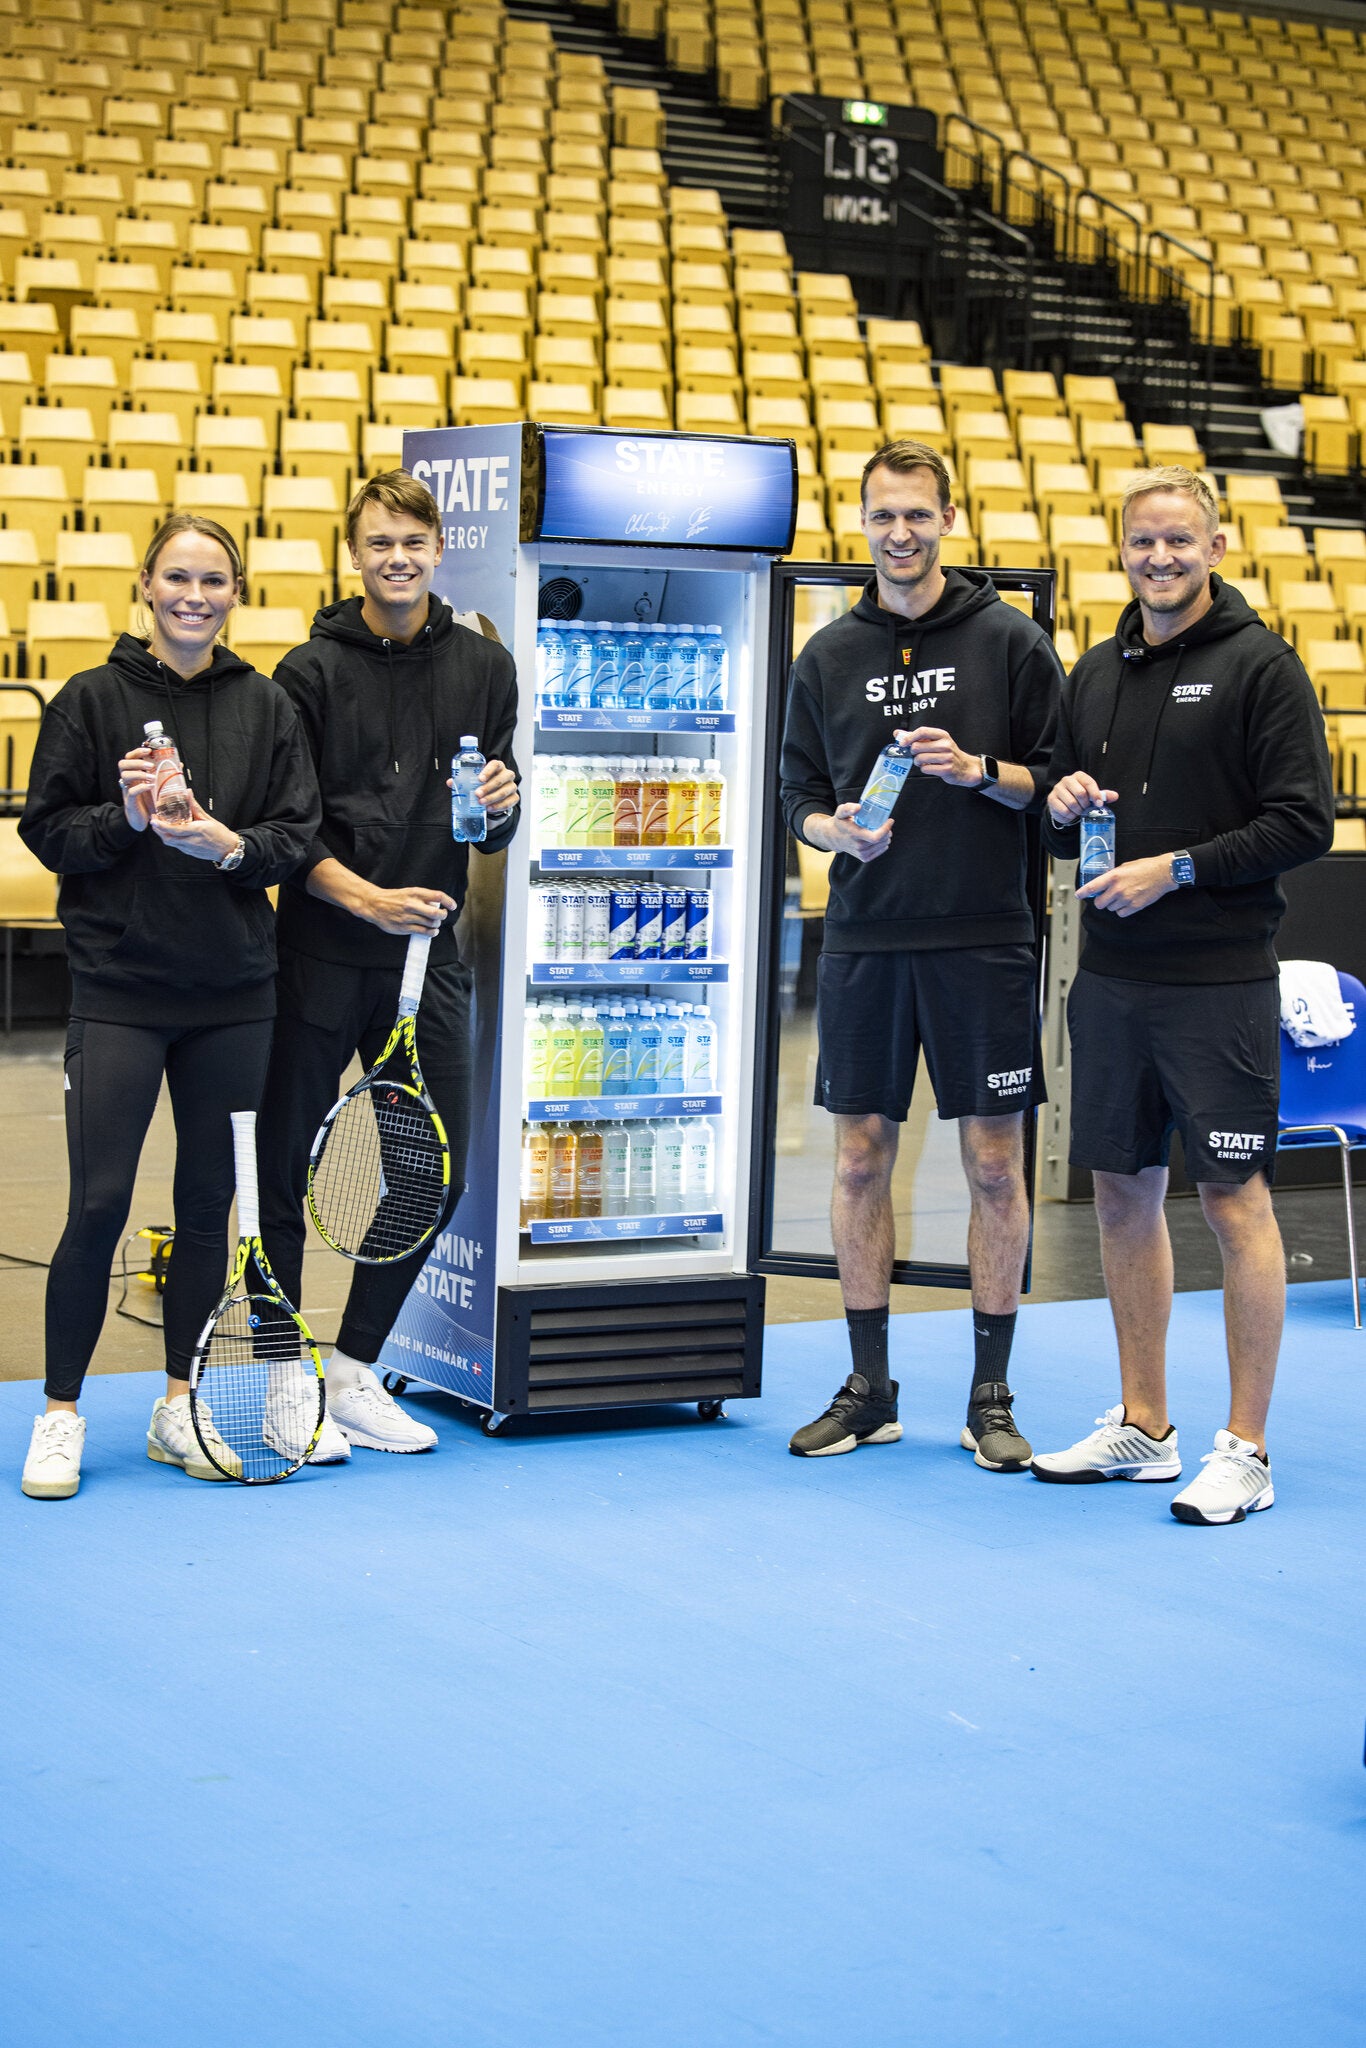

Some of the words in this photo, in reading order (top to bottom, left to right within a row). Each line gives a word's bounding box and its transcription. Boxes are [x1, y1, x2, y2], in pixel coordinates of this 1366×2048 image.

[824, 131, 899, 184] L13
[616, 441, 725, 478] STATE
[636, 481, 705, 497] ENERGY
[866, 668, 956, 702] STATE
[1172, 684, 1213, 697] STATE
[557, 714, 582, 722] STATE
[627, 716, 652, 724] STATE
[696, 717, 720, 725] STATE
[883, 760, 908, 775] STATE
[558, 853, 583, 861] STATE
[627, 853, 651, 861] STATE
[694, 853, 718, 861] STATE
[987, 1067, 1032, 1089] STATE
[998, 1086, 1027, 1097] ENERGY
[545, 1104, 570, 1113] STATE
[614, 1102, 639, 1110] STATE
[682, 1100, 706, 1108] STATE
[1208, 1131, 1265, 1151] STATE
[1217, 1151, 1253, 1160] ENERGY
[616, 1222, 640, 1230] STATE
[683, 1219, 707, 1227] STATE
[548, 1225, 573, 1234] STATE
[416, 1266, 473, 1311] STATE
[386, 1331, 410, 1348] MADE
[413, 1339, 423, 1354] IN
[425, 1345, 469, 1372] DENMARK
